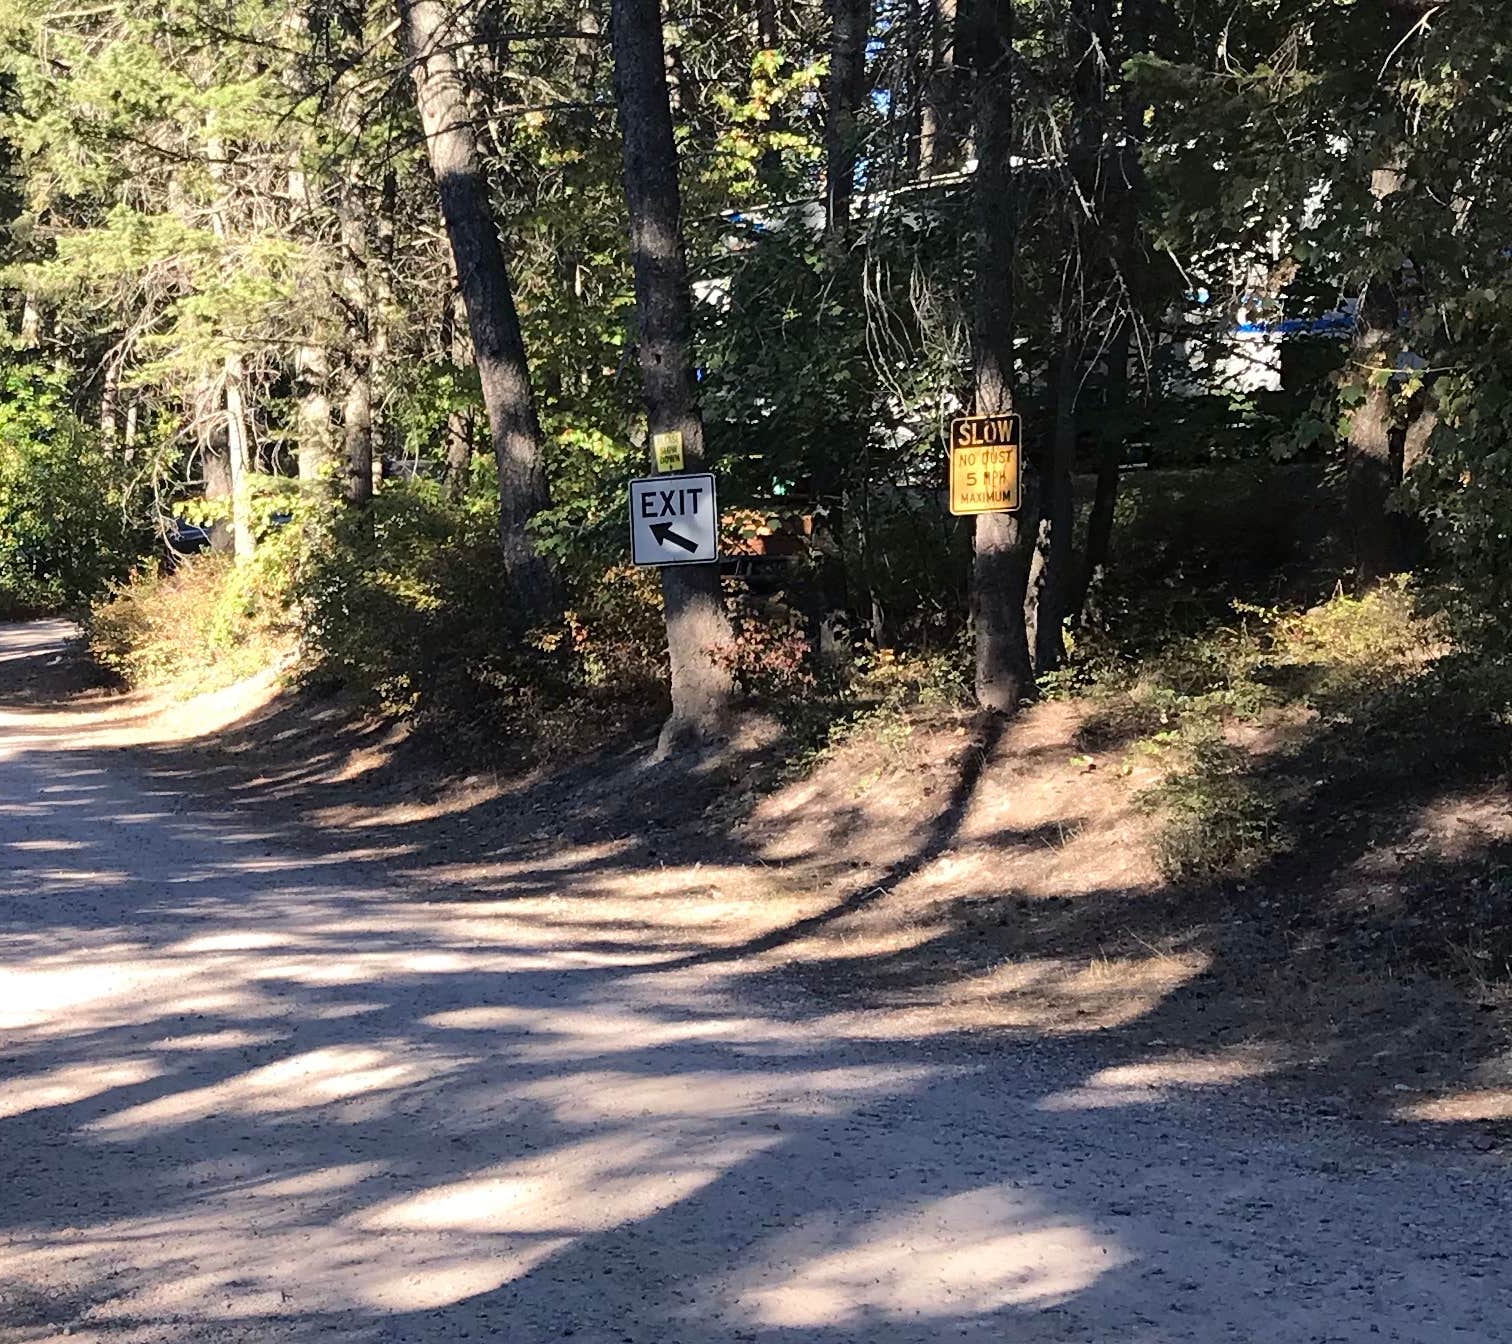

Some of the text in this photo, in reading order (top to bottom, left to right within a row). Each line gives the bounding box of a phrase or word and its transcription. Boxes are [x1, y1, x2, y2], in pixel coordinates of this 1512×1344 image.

[958, 420, 1013, 446] SLOW
[960, 450, 1013, 467] NO DUST
[967, 471, 1006, 486] 5 MPH
[641, 488, 703, 518] EXIT
[961, 491, 1010, 504] MAXIMUM
